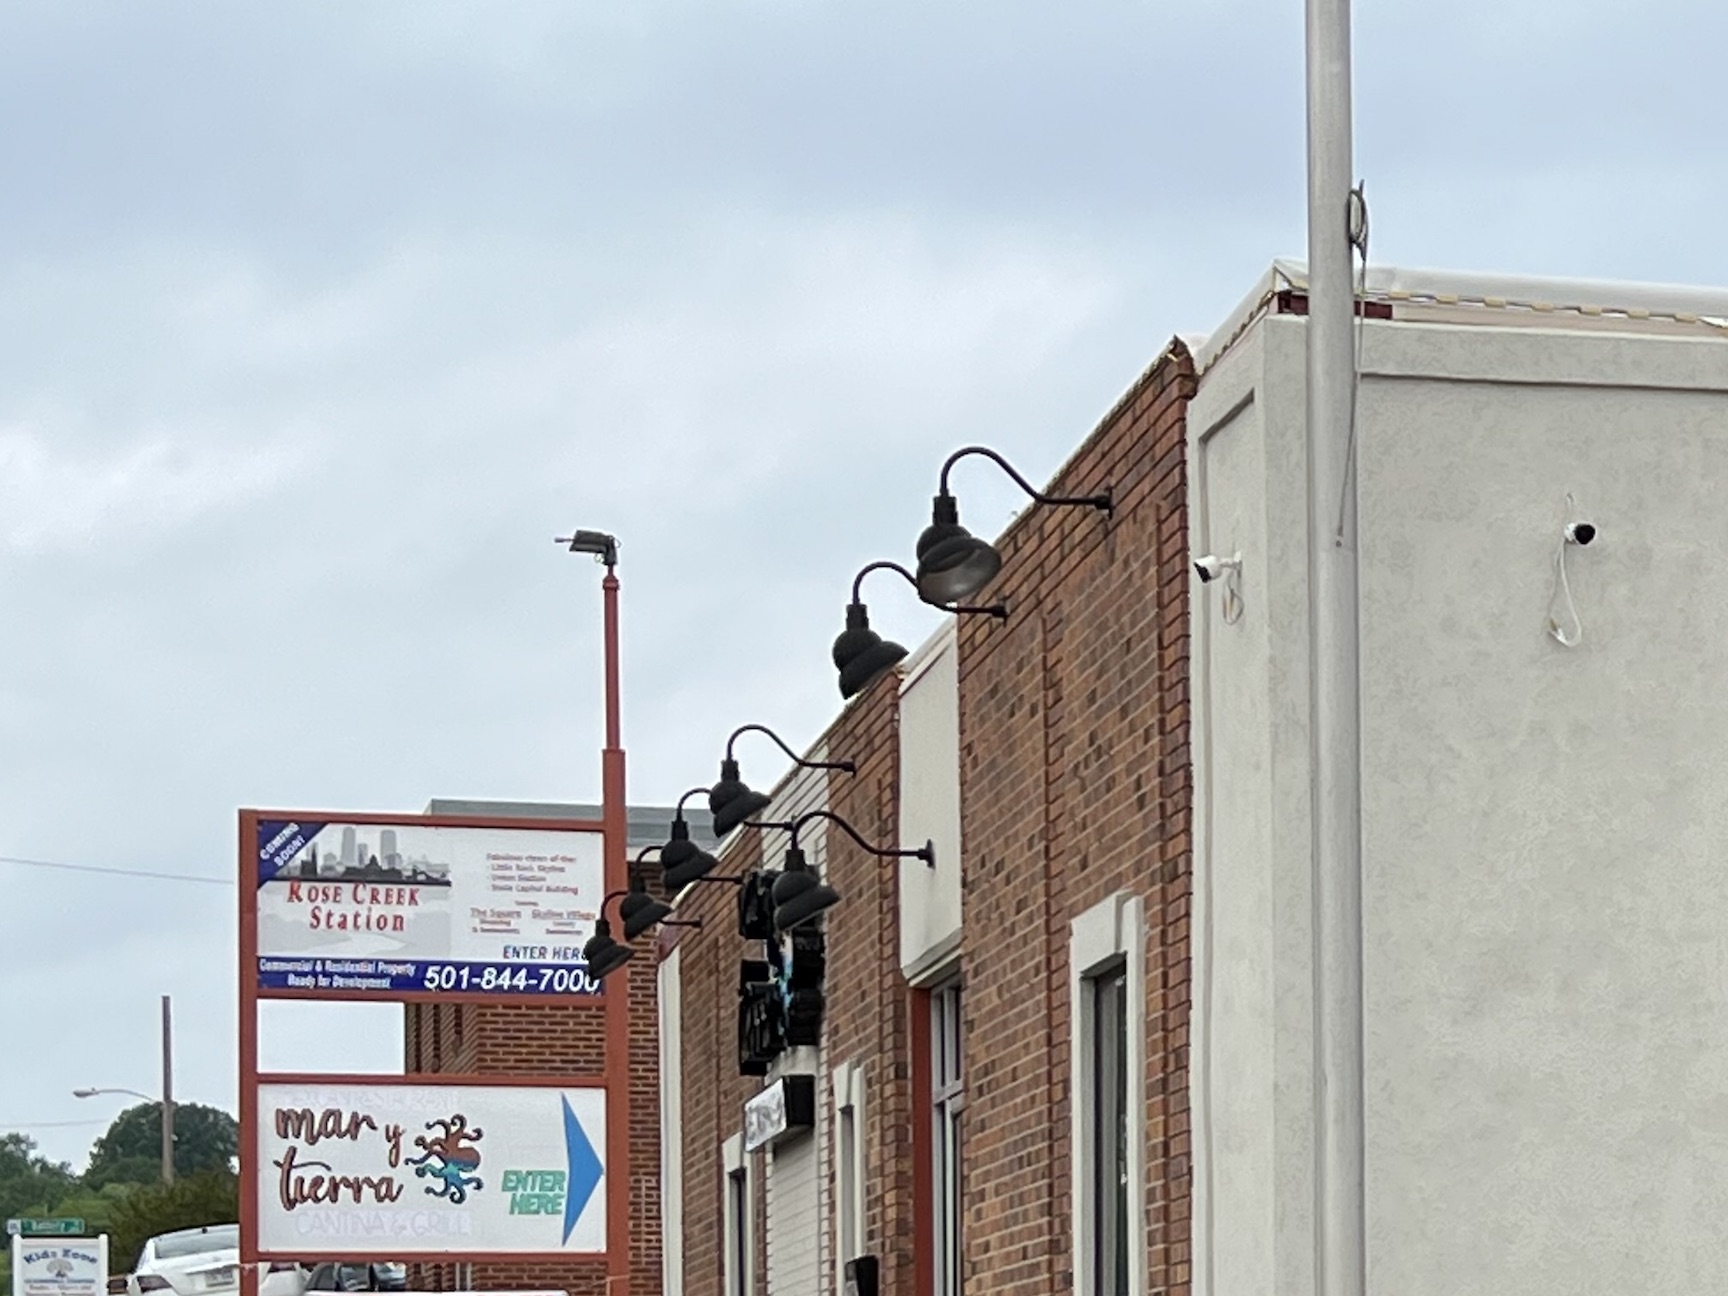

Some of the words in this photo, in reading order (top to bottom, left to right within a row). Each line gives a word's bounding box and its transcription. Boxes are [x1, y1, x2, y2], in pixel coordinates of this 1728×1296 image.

[260, 822, 300, 860] COMING
[309, 905, 405, 932] Station
[503, 945, 547, 960] ENTER
[552, 946, 585, 961] HER
[275, 1108, 378, 1145] mar
[385, 1123, 406, 1168] y
[273, 1145, 405, 1211] tierra
[501, 1170, 566, 1192] ENTER
[509, 1193, 566, 1215] HERE
